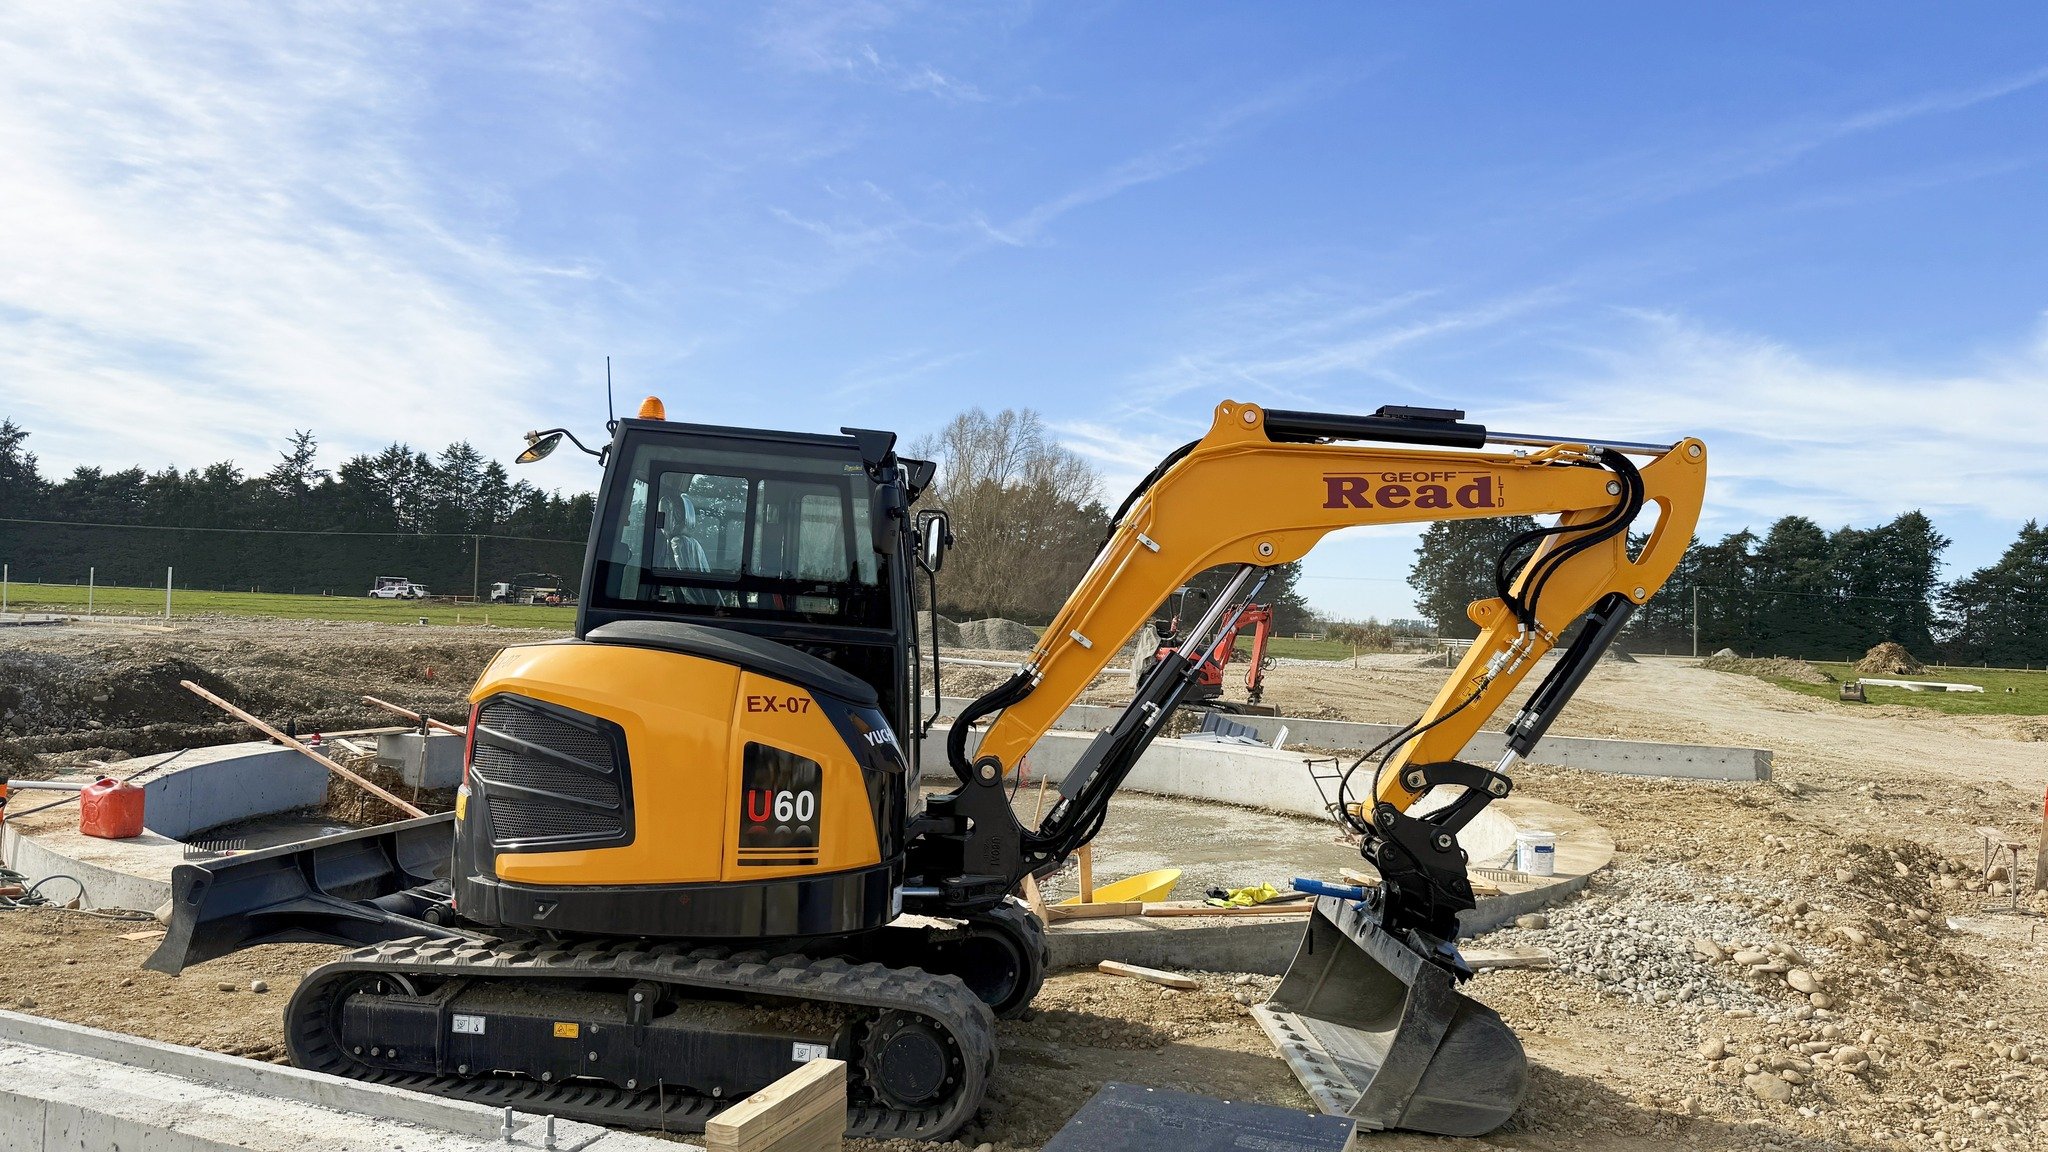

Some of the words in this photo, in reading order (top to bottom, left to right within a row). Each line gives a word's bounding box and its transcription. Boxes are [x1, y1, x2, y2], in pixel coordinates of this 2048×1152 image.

[1381, 472, 1457, 482] GEOFF
[1323, 476, 1495, 508] Read
[746, 695, 811, 714] EX-07
[748, 790, 815, 822] U60
